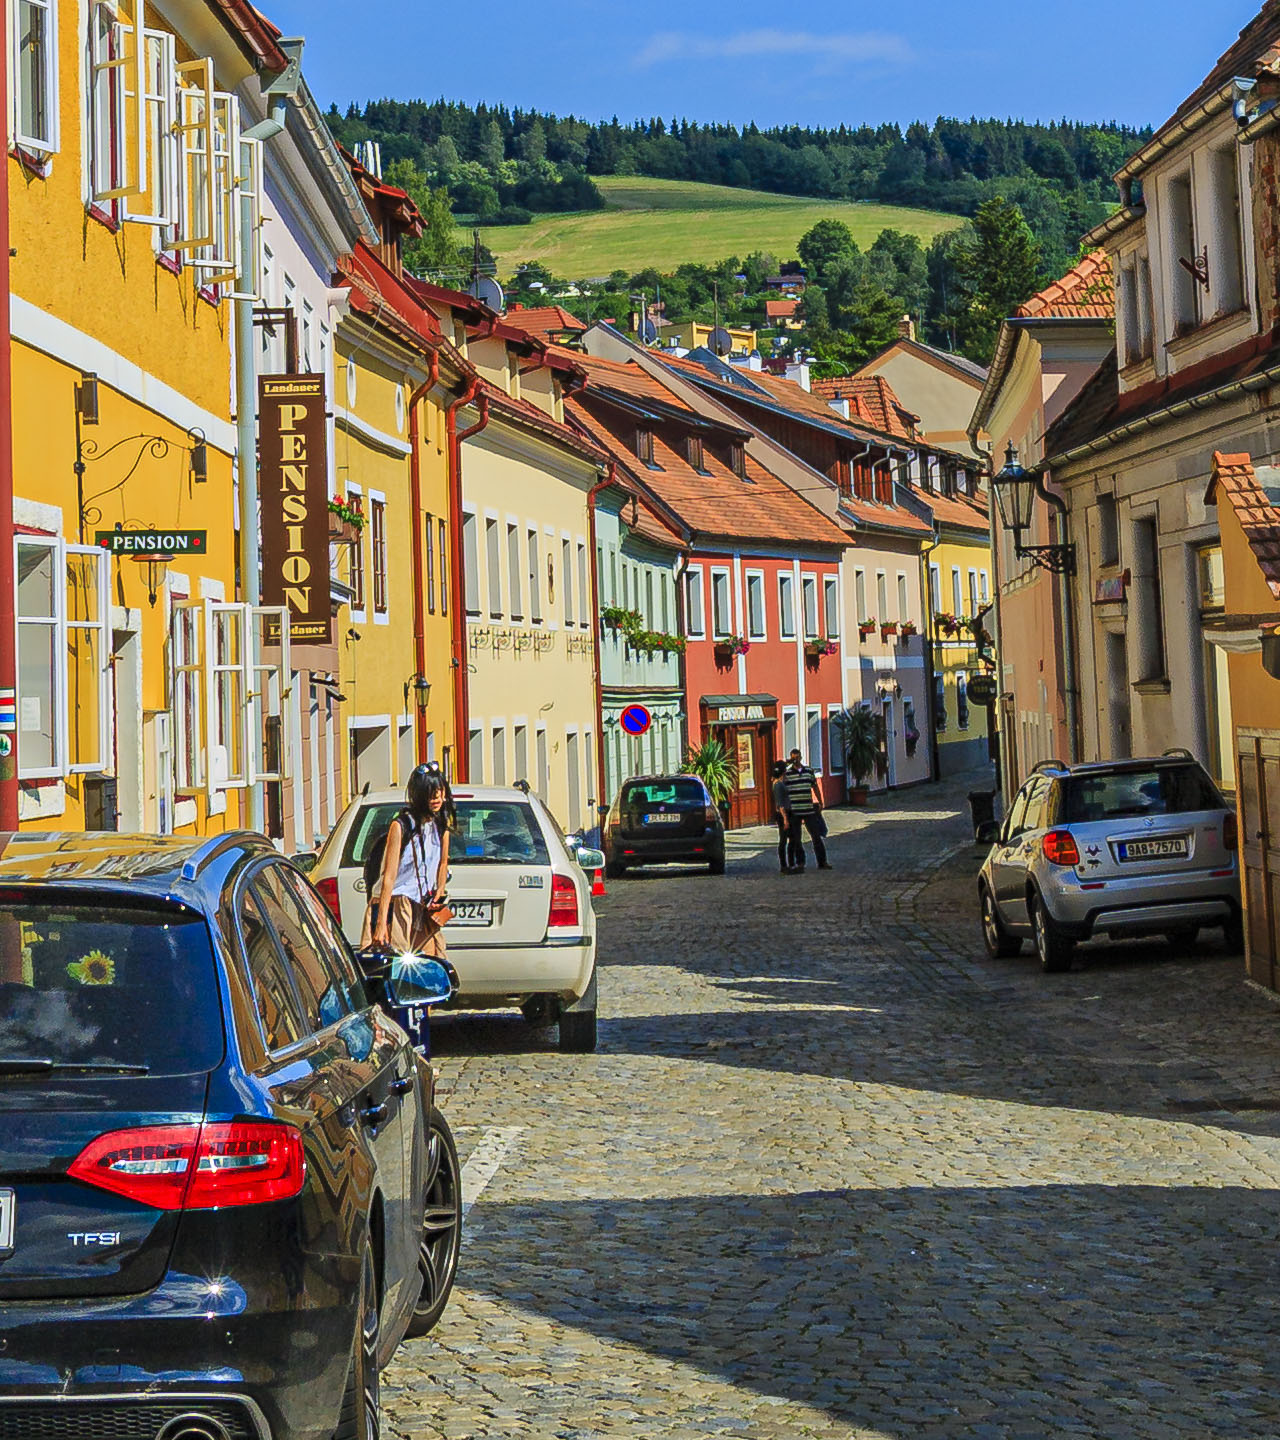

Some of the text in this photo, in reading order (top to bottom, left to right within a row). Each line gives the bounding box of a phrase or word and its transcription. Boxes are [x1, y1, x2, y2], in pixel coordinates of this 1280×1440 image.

[264, 383, 320, 393] Landauer
[277, 404, 312, 614] PENSION
[113, 535, 188, 550] PENSION
[269, 626, 326, 636] Ladauer
[1128, 841, 1181, 856] 9A8 7570
[67, 1231, 120, 1246] TFSI
